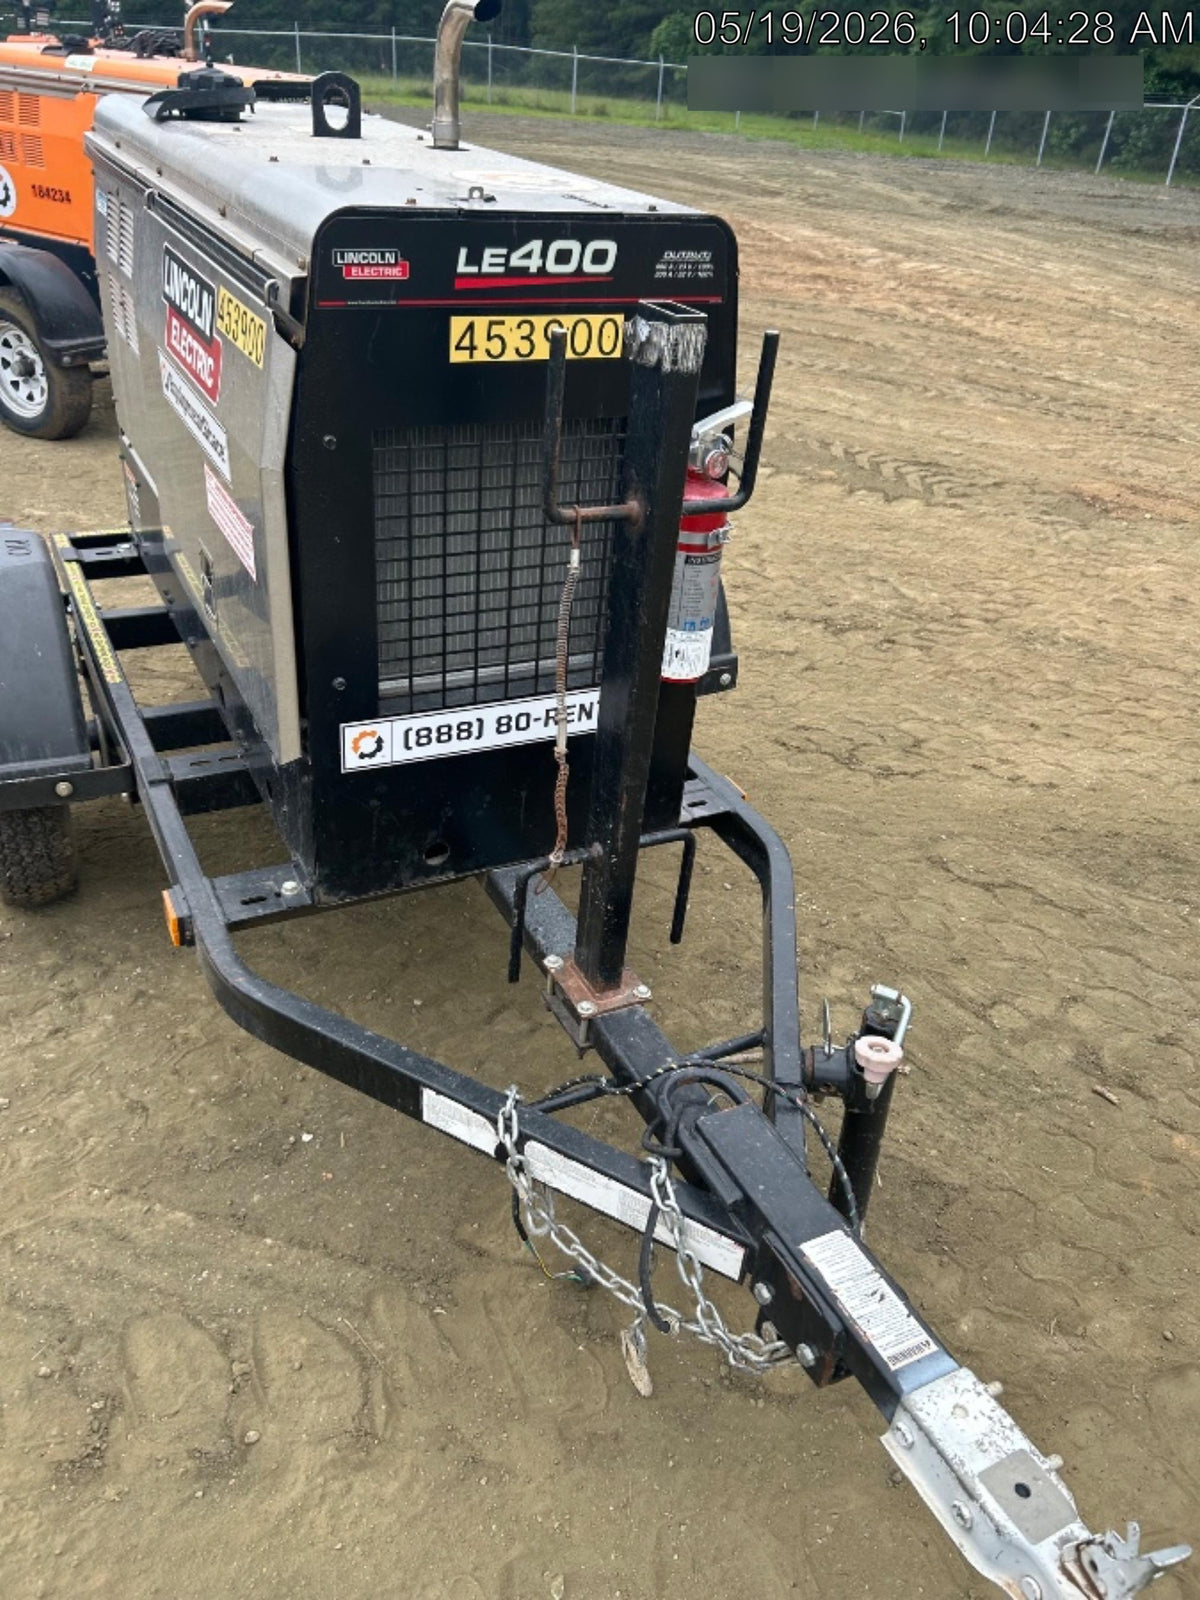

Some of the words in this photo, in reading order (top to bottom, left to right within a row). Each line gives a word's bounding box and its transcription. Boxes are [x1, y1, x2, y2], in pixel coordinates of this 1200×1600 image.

[337, 252, 396, 264] LINCOLN
[351, 266, 403, 277] ELECTRIC
[456, 239, 618, 274] LE400
[164, 255, 214, 338] LINCOLN
[171, 317, 215, 389] ELECTRIC
[217, 291, 265, 366] 453900
[403, 717, 485, 751] (888)
[495, 700, 600, 735] 80-REN
